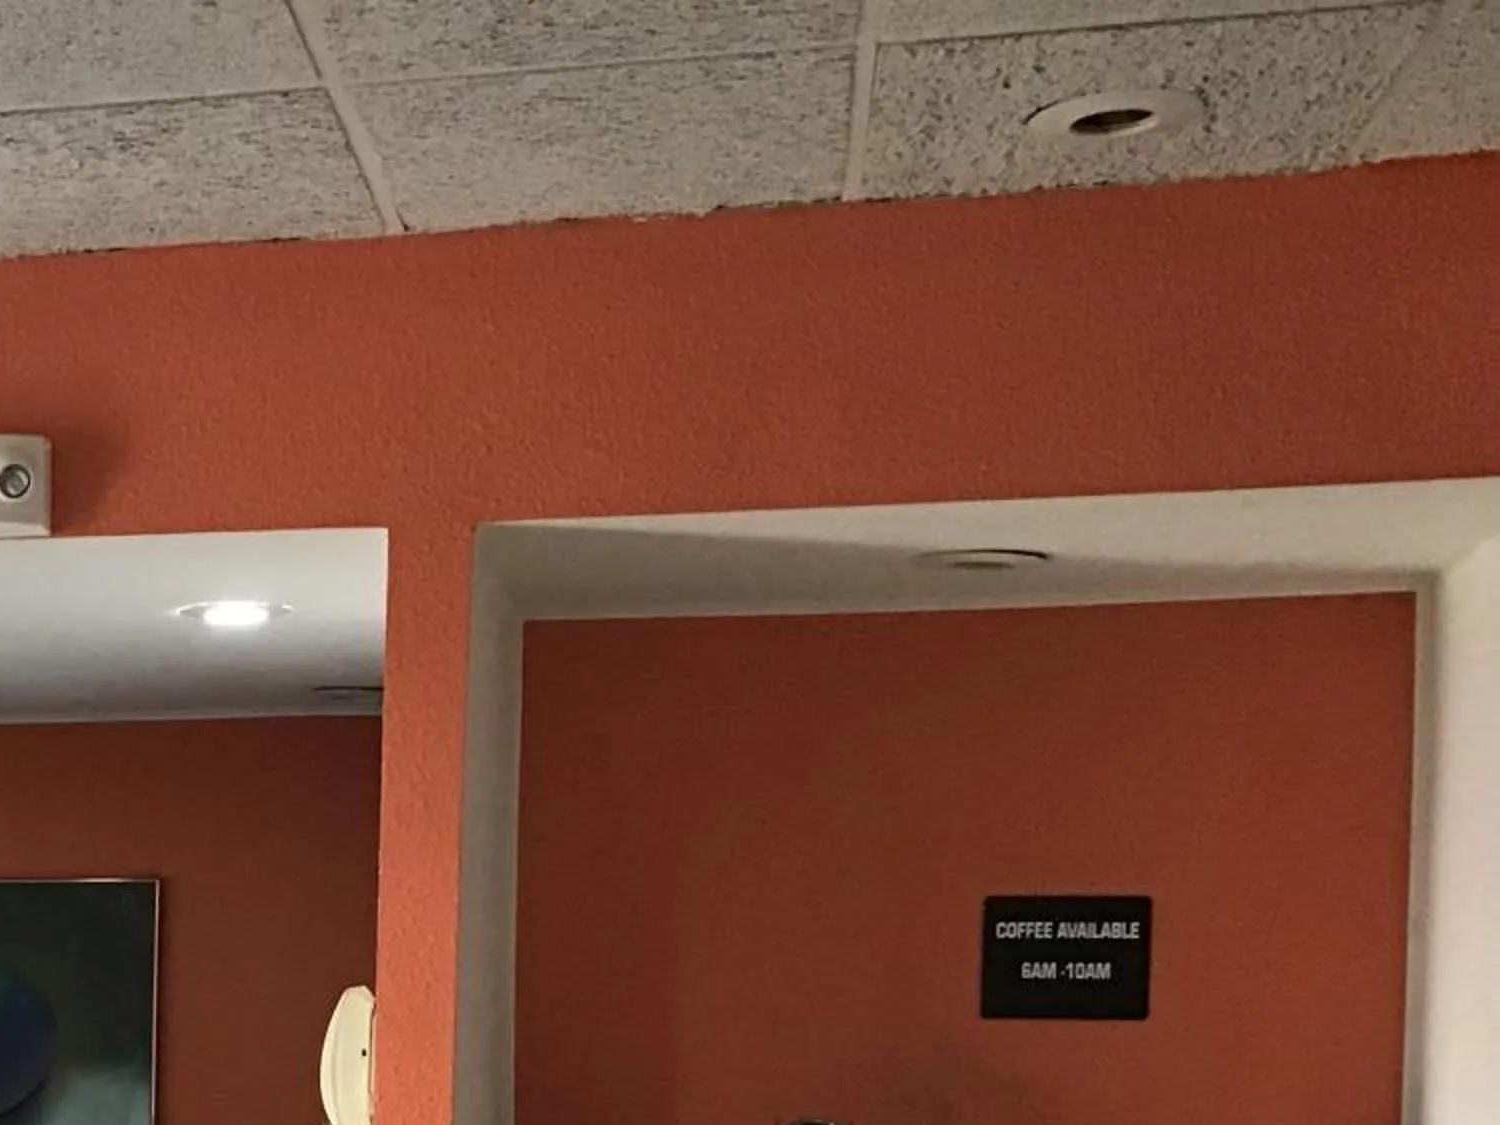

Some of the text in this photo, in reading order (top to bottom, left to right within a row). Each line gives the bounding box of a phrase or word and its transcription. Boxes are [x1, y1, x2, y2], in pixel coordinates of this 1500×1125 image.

[995, 921, 1141, 939] COFFEE AVAILABLE
[1021, 962, 1057, 980] 6AM
